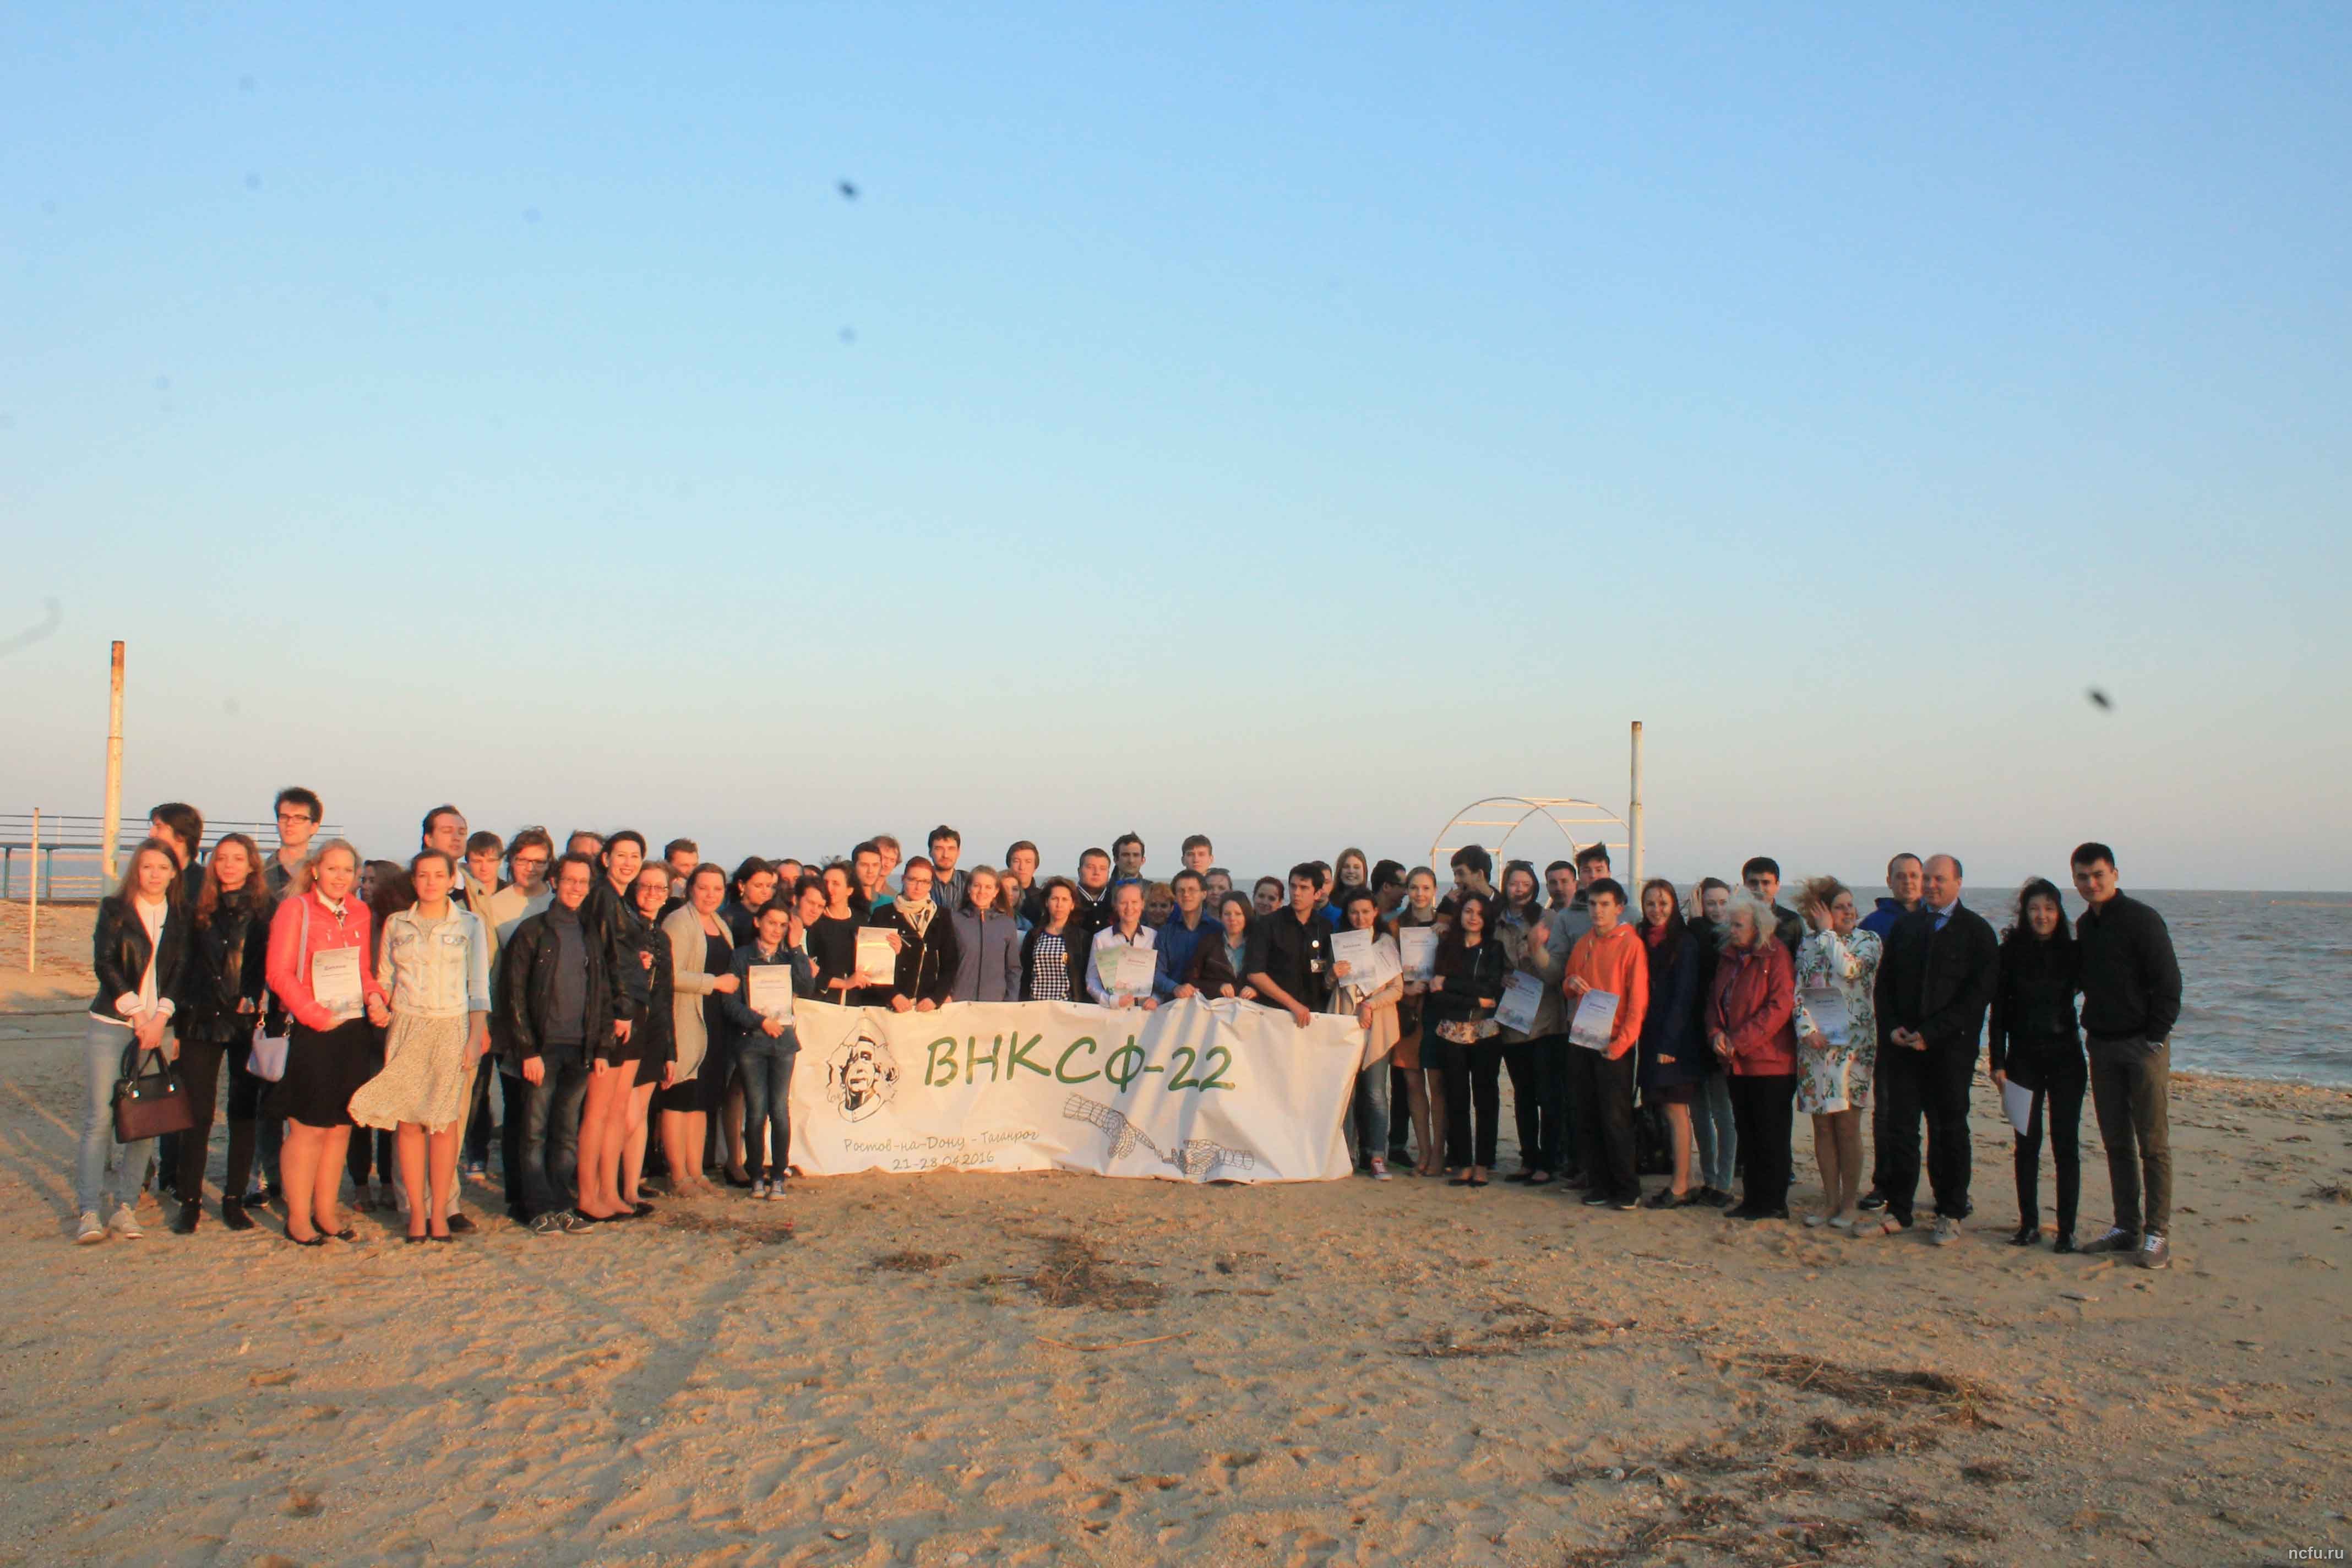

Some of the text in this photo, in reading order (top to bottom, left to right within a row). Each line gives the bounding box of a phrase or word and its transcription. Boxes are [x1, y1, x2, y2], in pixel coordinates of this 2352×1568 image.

[925, 1031, 1235, 1093] ВНКСФ-22
[844, 1136, 965, 1152] Ростов-на-Дону
[982, 1130, 1039, 1145] Таганрог
